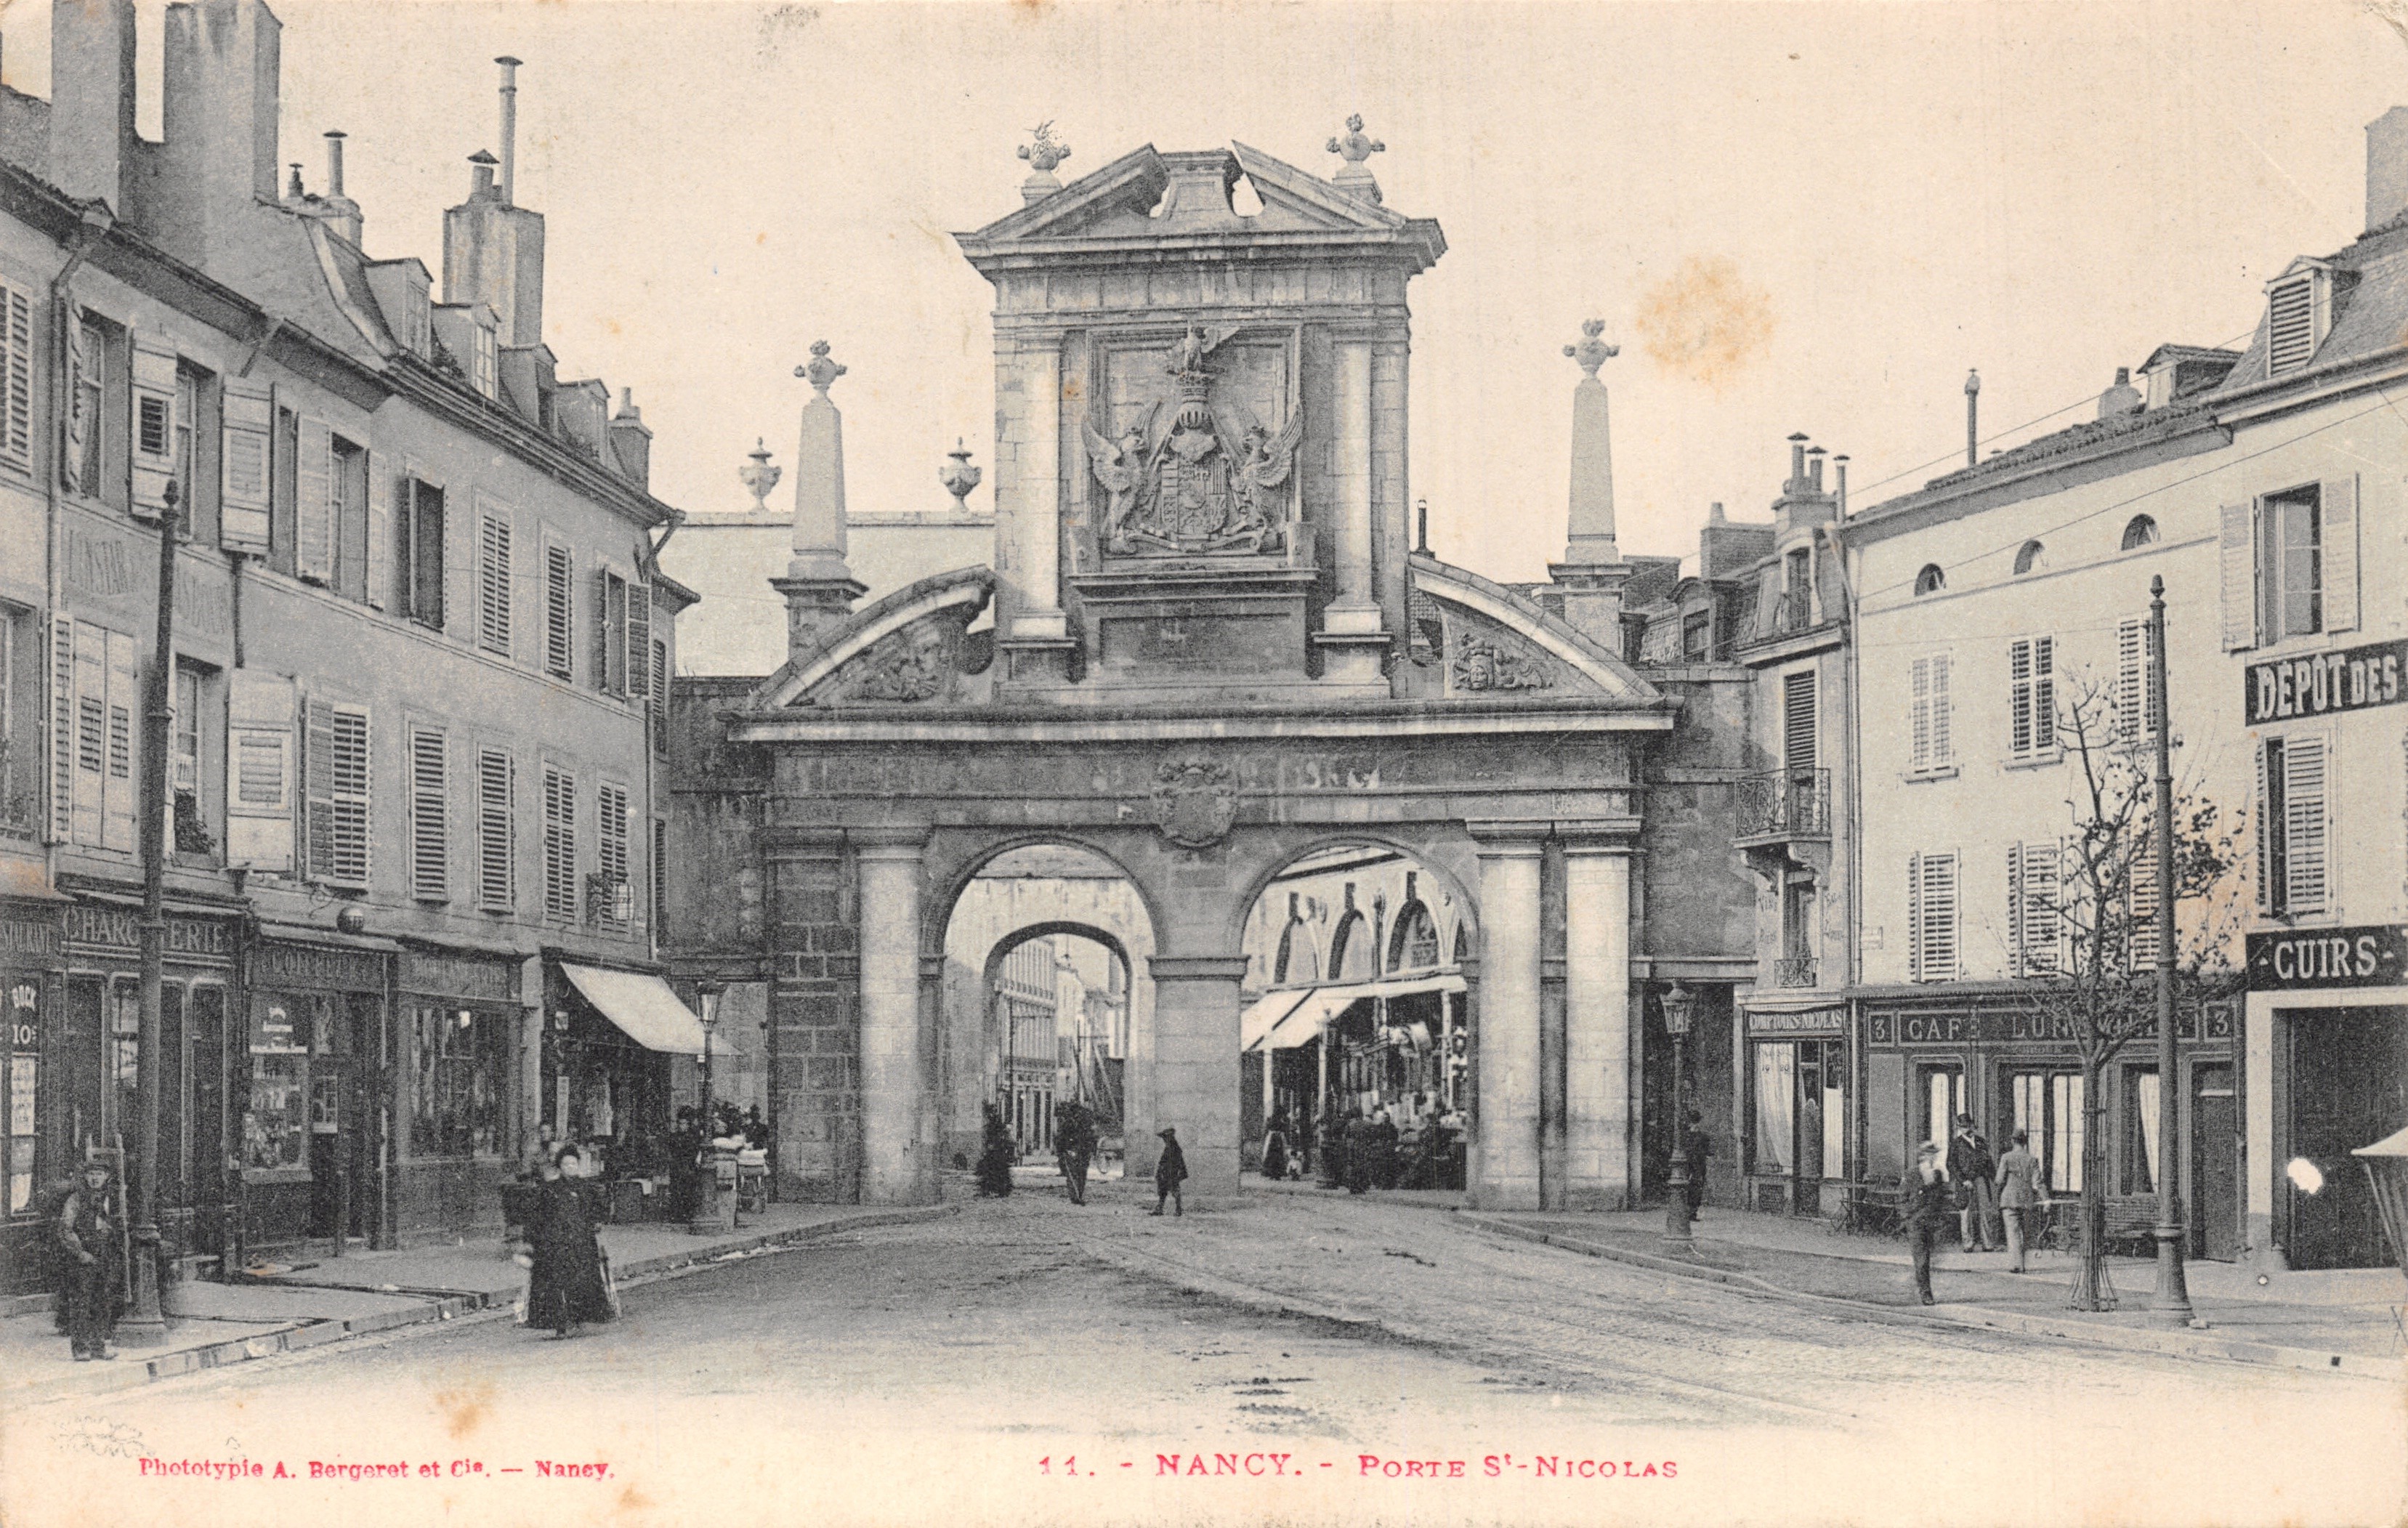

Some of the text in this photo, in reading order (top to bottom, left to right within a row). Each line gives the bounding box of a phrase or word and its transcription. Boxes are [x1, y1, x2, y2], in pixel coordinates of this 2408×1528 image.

[2255, 655, 2398, 719] DÉPÔT DES
[2274, 935, 2377, 980] CUIRS
[1874, 1019, 1886, 1040] 3
[2215, 1011, 2229, 1035] 3
